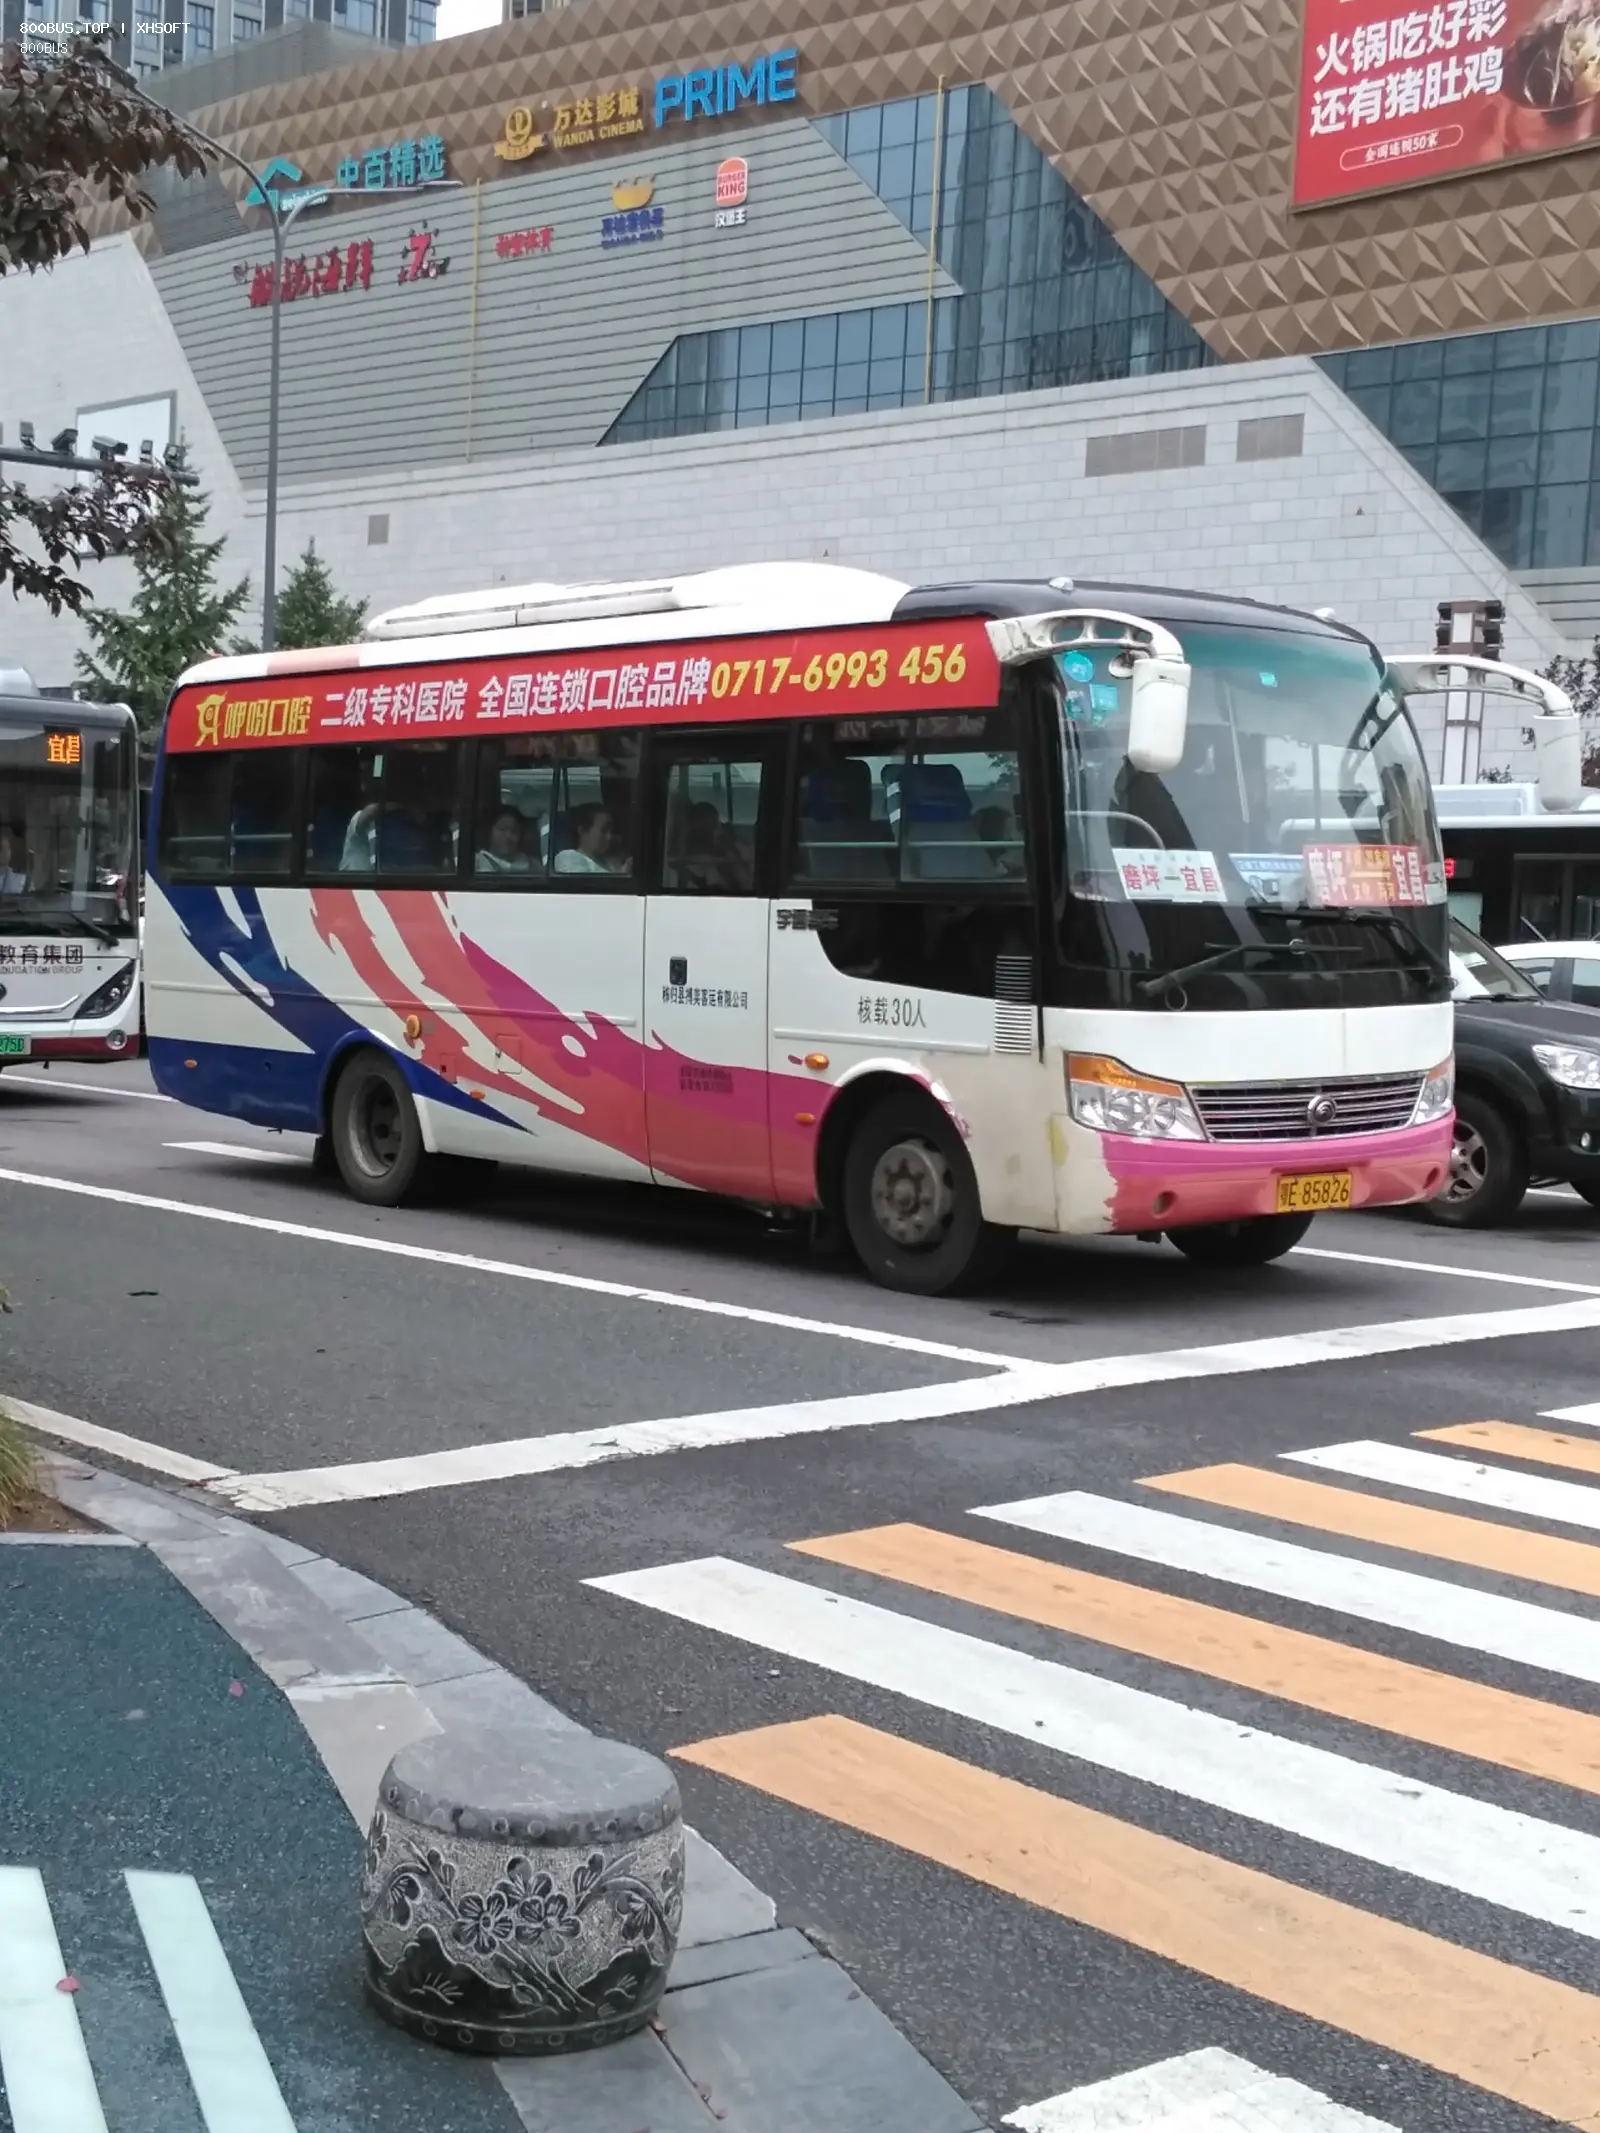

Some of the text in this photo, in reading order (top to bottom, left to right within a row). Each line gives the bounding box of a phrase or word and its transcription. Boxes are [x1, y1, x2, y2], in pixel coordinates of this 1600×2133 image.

[1313, 0, 1507, 83] 火锅吃好彩
[553, 86, 640, 131] 万达影城
[655, 48, 798, 129] PRIME
[1309, 46, 1503, 137] 还有猪肚鸡
[553, 118, 645, 149] WANDA CINEMA
[336, 134, 445, 190] 中百精选
[718, 181, 746, 198] KING
[321, 679, 467, 728] 二级专科医院
[477, 657, 710, 718] 全国连锁口腔品牌
[711, 649, 887, 699] 0717-6993
[898, 643, 967, 685] 456
[0, 945, 83, 965] 教育集团
[858, 995, 926, 1029] 核载30人
